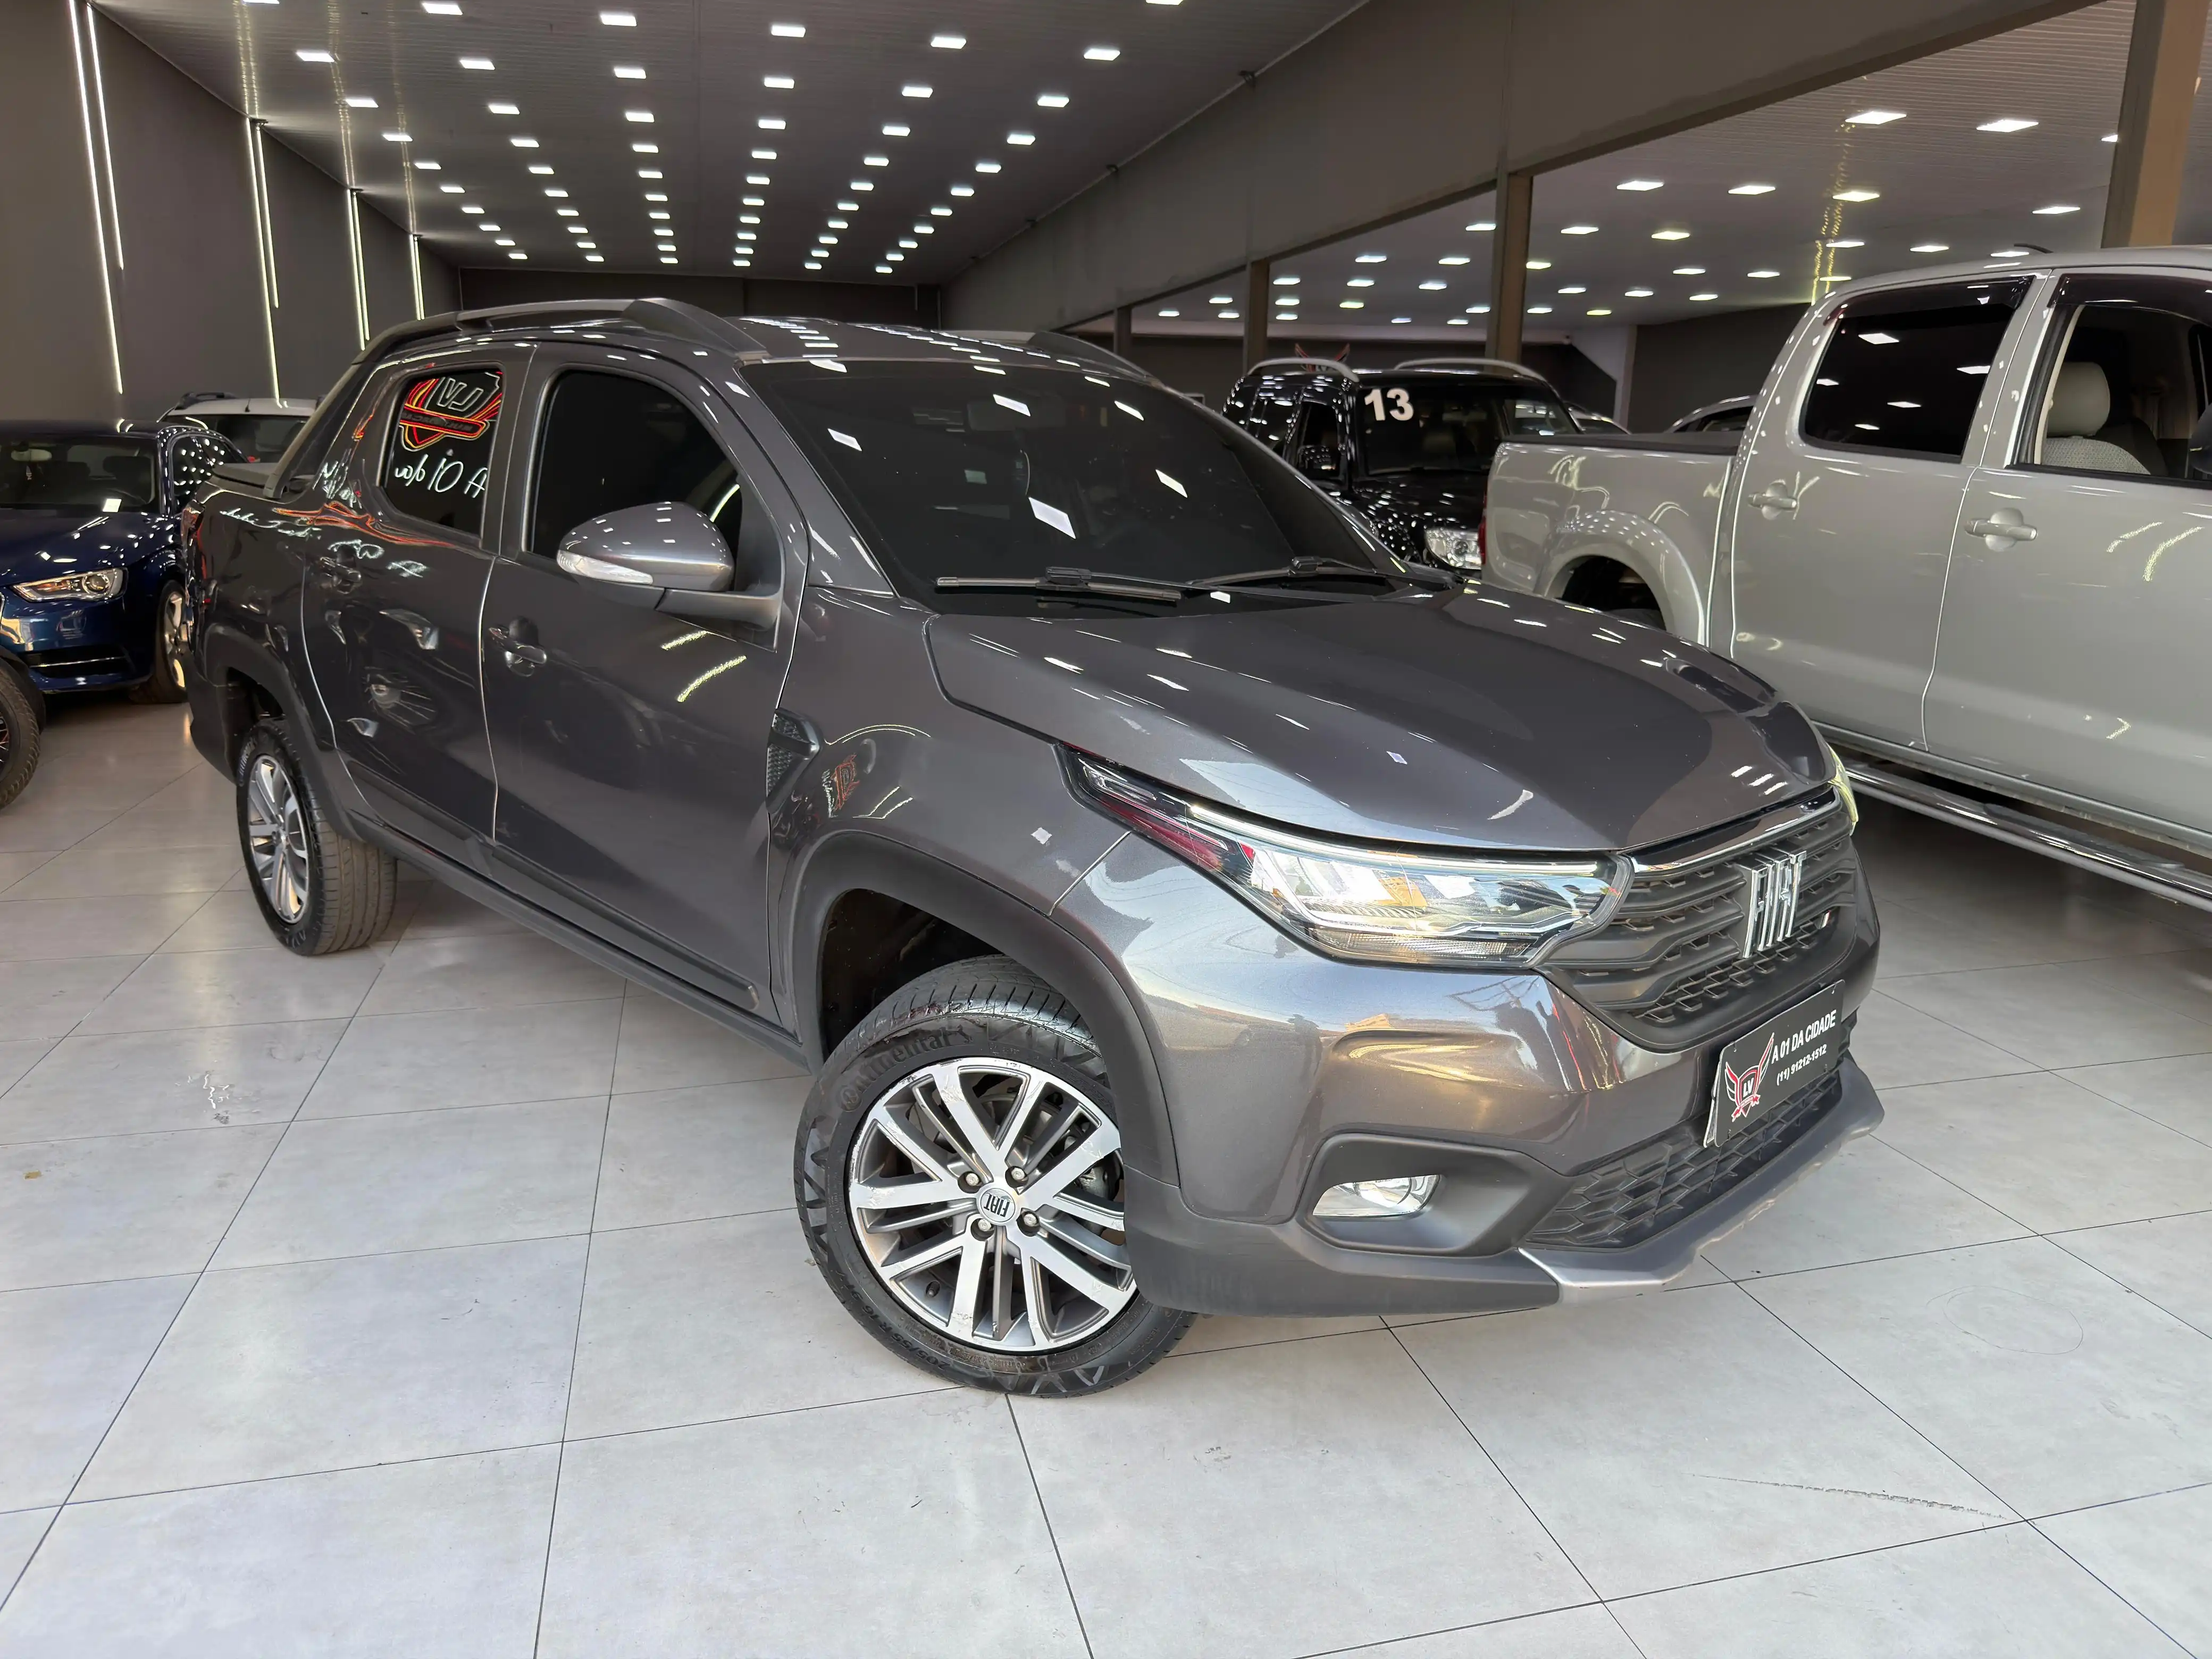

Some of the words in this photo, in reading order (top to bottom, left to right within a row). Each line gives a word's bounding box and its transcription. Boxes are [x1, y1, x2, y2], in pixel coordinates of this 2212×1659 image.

[1364, 389, 1414, 421] 13
[1772, 1045, 1779, 1064] A
[1780, 1038, 1790, 1058] 01
[1791, 1030, 1804, 1052] DA
[1805, 1010, 1837, 1042] CIDADE
[1777, 1068, 1790, 1086] (11)
[1791, 1044, 1827, 1075] 91212-1512
[1743, 1077, 1754, 1097] LV
[983, 1194, 1010, 1217] FIAT
[891, 1333, 951, 1370] 205/55
